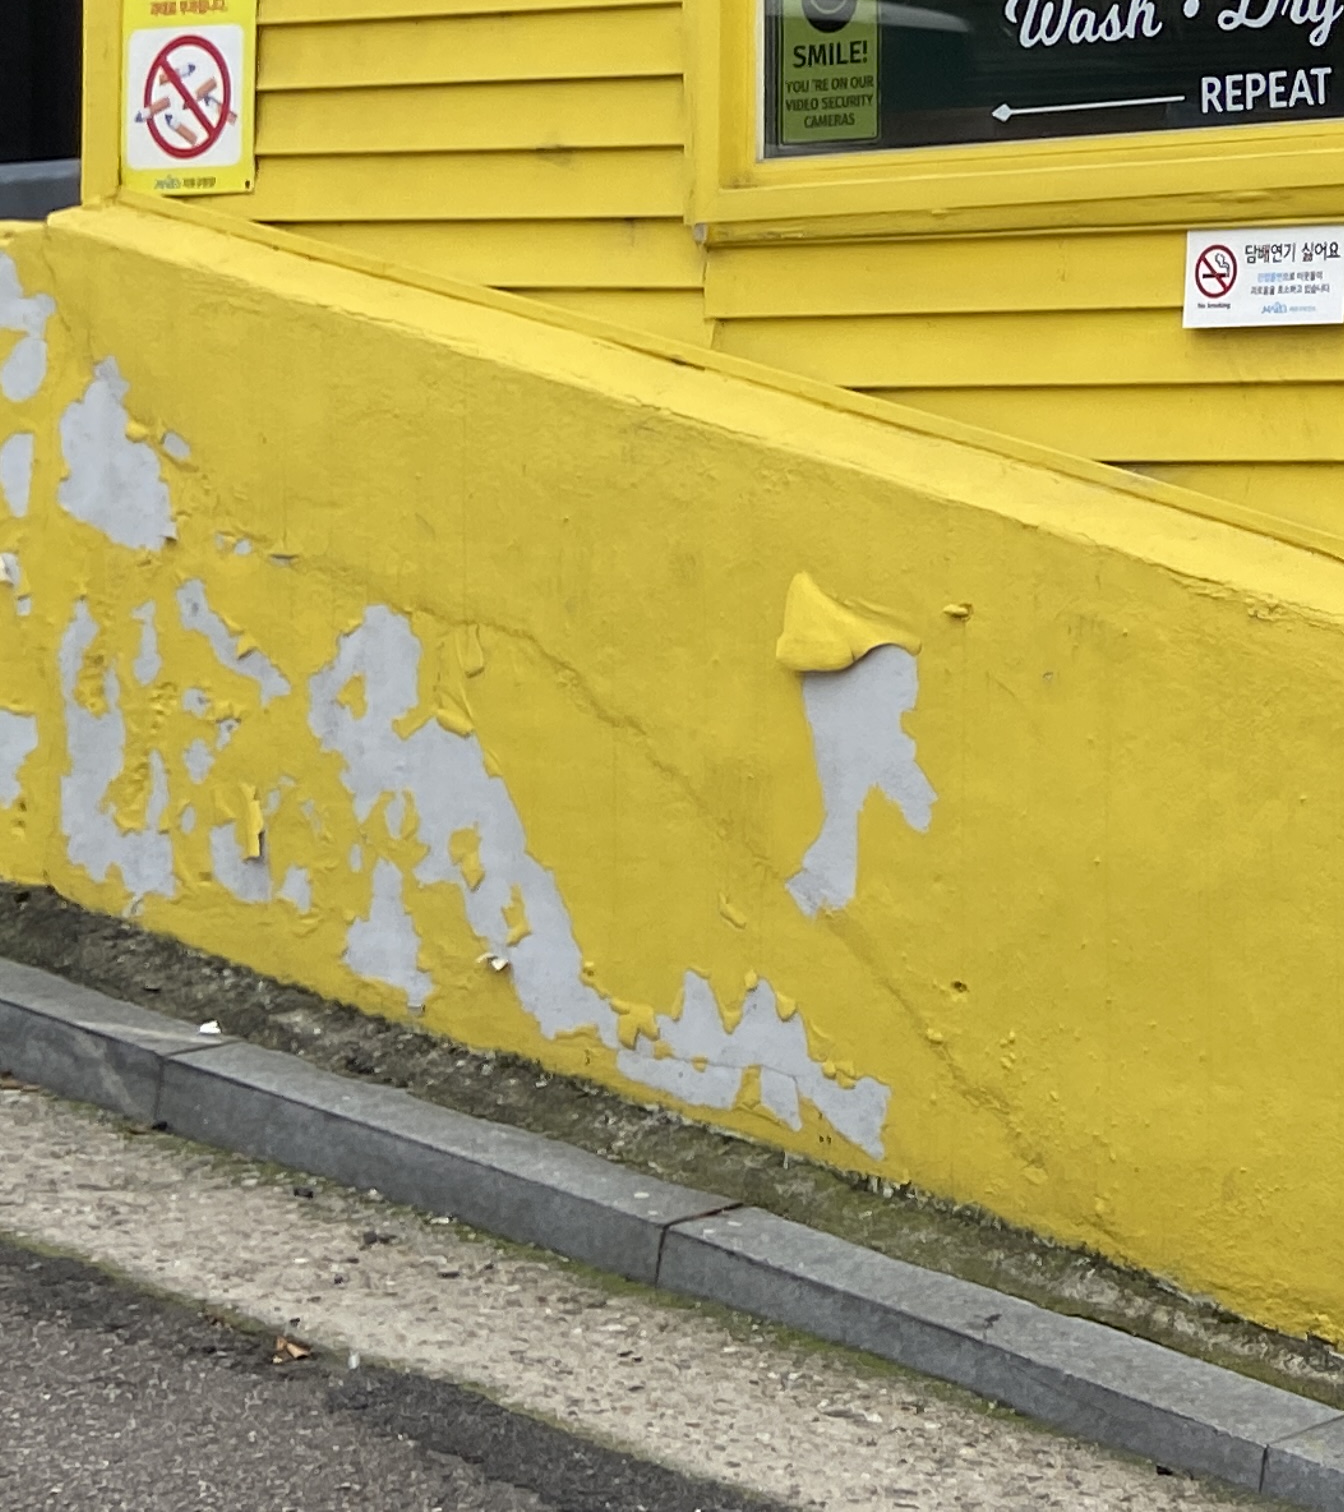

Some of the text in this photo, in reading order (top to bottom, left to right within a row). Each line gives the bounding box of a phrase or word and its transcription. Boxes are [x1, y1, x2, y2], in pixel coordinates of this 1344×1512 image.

[793, 40, 868, 68] SMILE!
[831, 77, 848, 91] ON
[850, 75, 874, 89] OUR
[1200, 67, 1332, 116] REPEAT
[785, 94, 874, 112] VIDEO SECURITY
[804, 113, 855, 129] CAMERAS
[1245, 241, 1341, 264] 담배연기 싫어요
